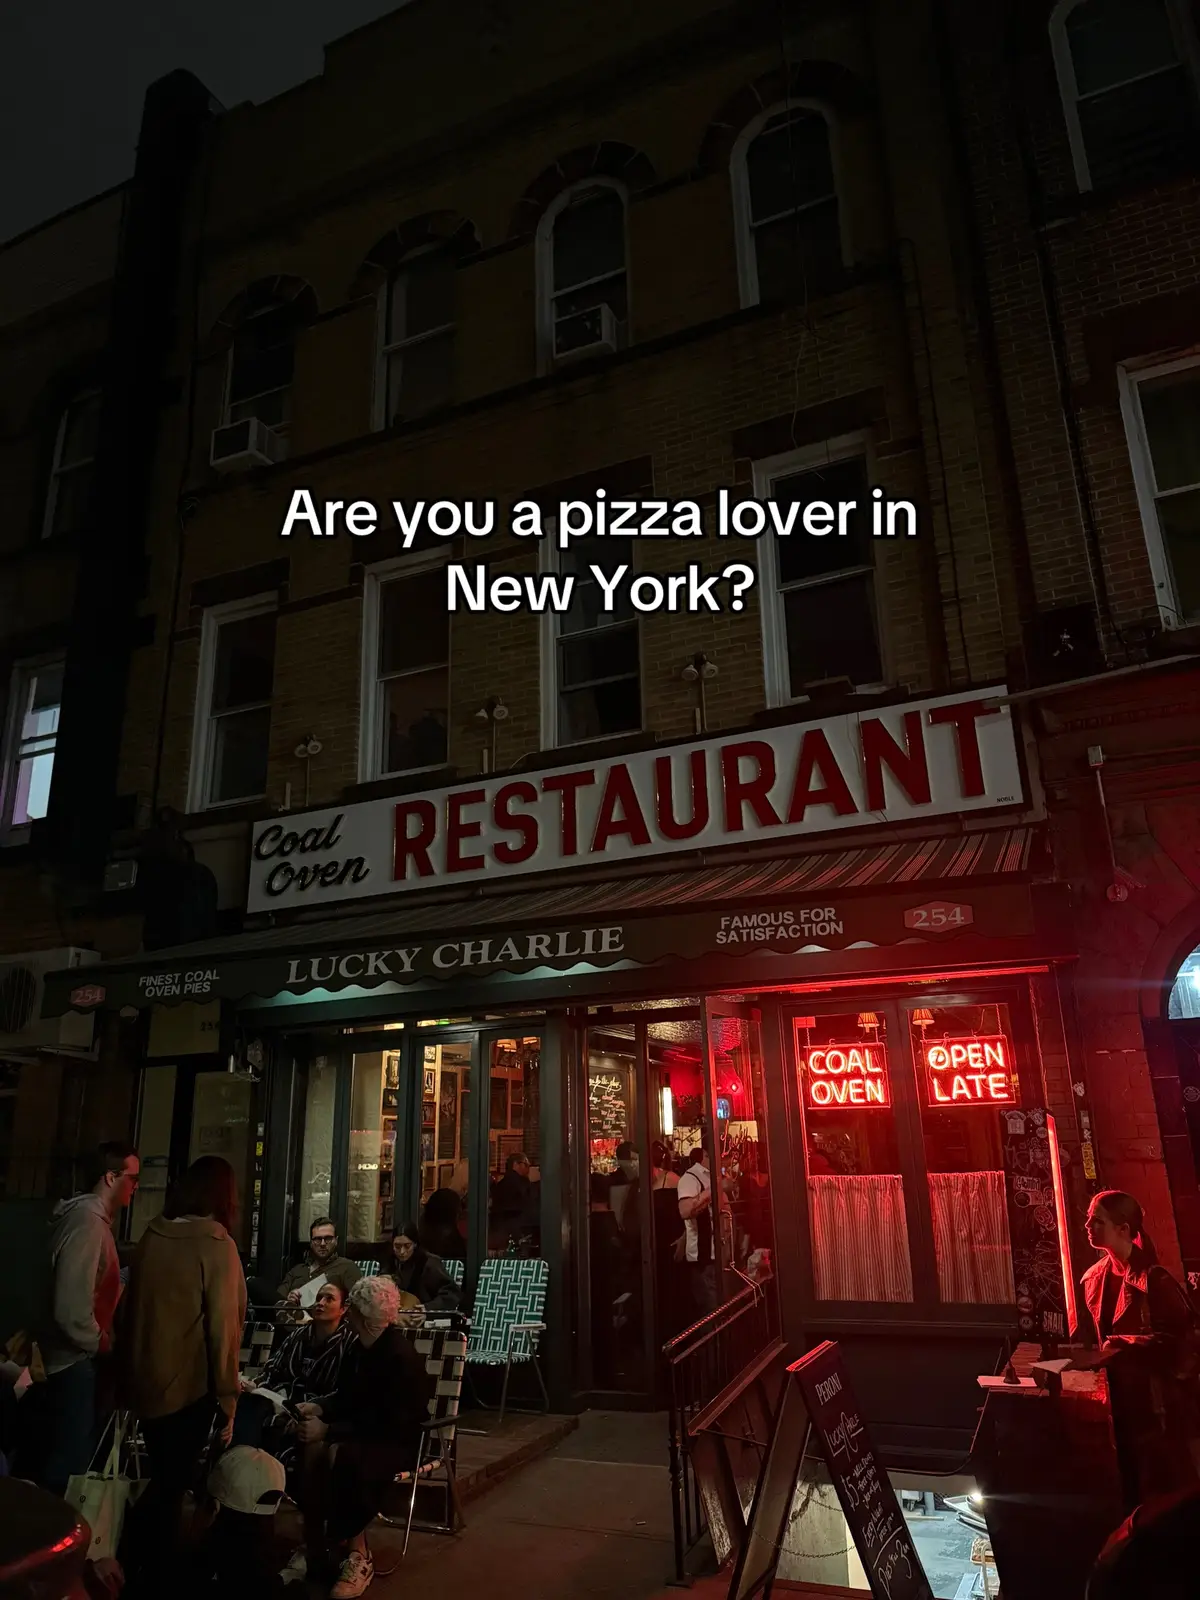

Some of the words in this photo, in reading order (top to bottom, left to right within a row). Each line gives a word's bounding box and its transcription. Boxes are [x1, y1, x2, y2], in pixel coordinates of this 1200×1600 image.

[391, 699, 1001, 881] RESTAURANT
[254, 813, 345, 861] Coal
[266, 856, 371, 897] Oven
[720, 910, 795, 930] FAMOUS
[800, 907, 837, 922] FOR
[912, 906, 965, 927] 254
[715, 921, 844, 944] SATISFACTION
[286, 947, 423, 984] LUCKY
[432, 926, 625, 969] CHARLIE
[138, 973, 182, 988] FINEST
[184, 968, 221, 983] COAL
[145, 985, 181, 997] OVEN
[184, 981, 212, 994] PIES
[76, 989, 102, 1003] 254
[808, 1048, 883, 1075] COAL
[927, 1041, 1006, 1071] OPEN
[811, 1078, 886, 1105] OVEN
[932, 1072, 1009, 1102] LATE
[814, 1372, 843, 1406] PERONI
